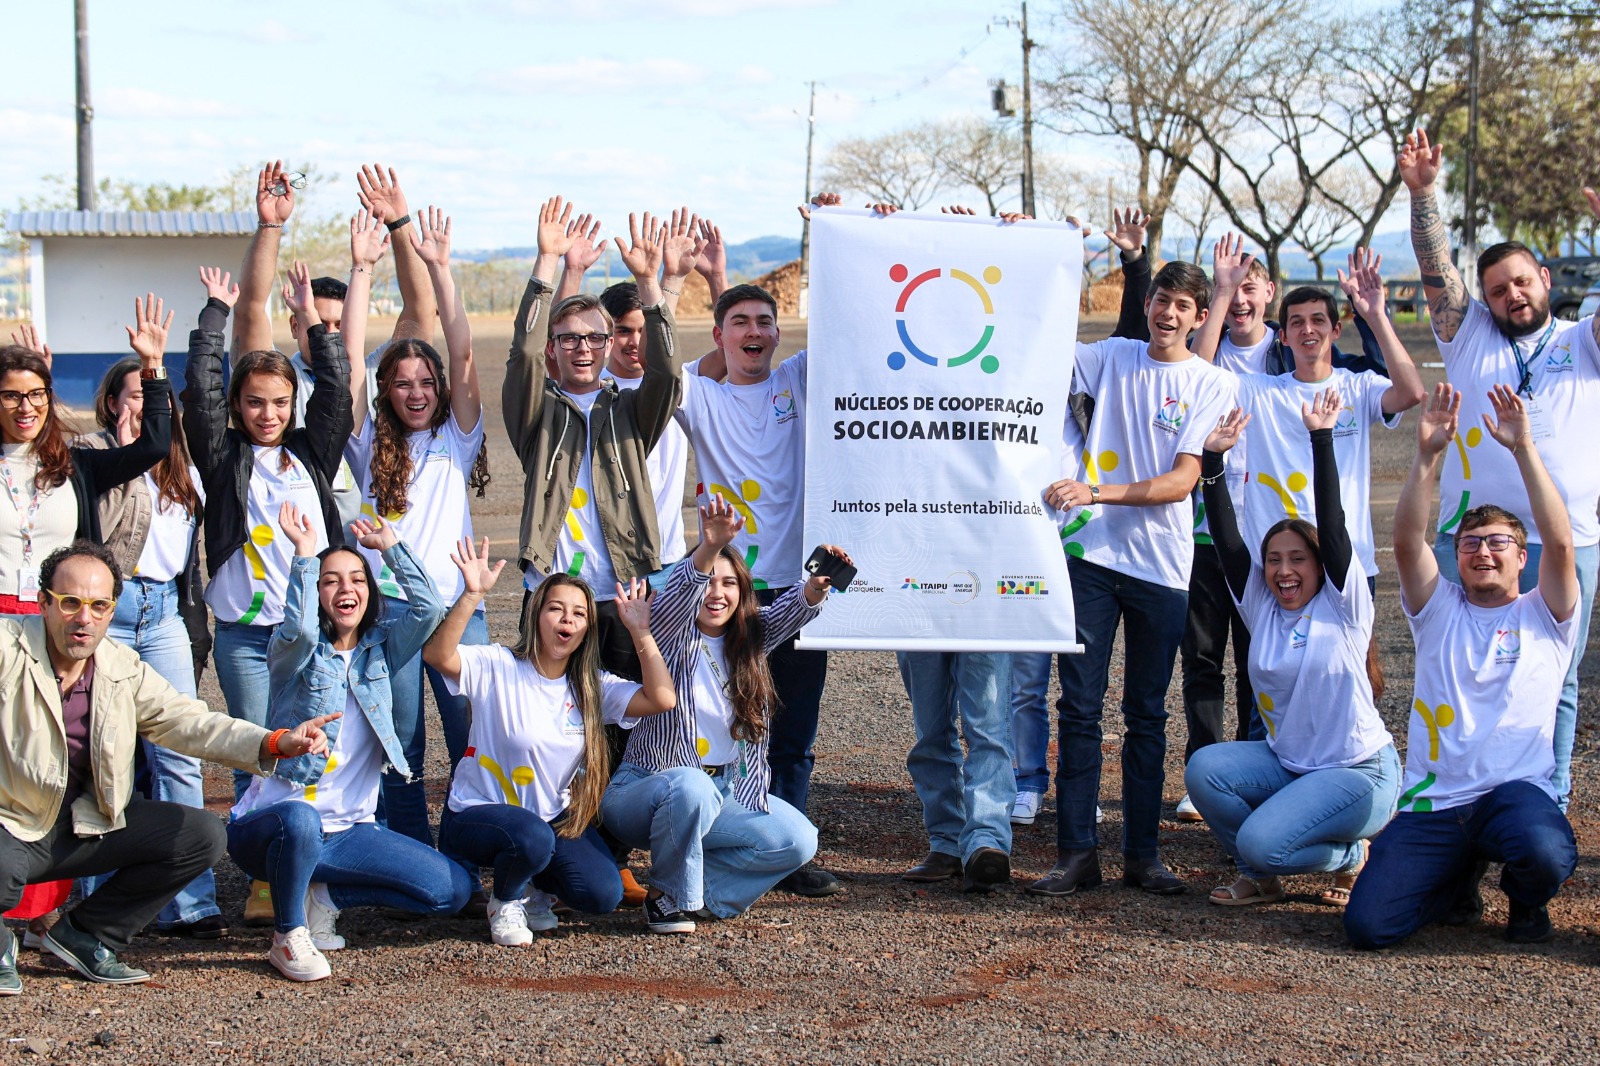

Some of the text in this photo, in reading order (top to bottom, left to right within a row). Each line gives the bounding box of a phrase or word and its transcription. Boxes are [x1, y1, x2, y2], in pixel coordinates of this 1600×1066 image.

[834, 392, 1044, 418] NÚCLEOS DE COOPERAÇÃO
[833, 420, 1039, 445] SOCIOAMBIENTAL
[831, 498, 1043, 517] Juntos pela sustentabilidade
[848, 586, 885, 594] parquetec
[850, 578, 869, 587] taipu
[996, 580, 1049, 595] BRASIL
